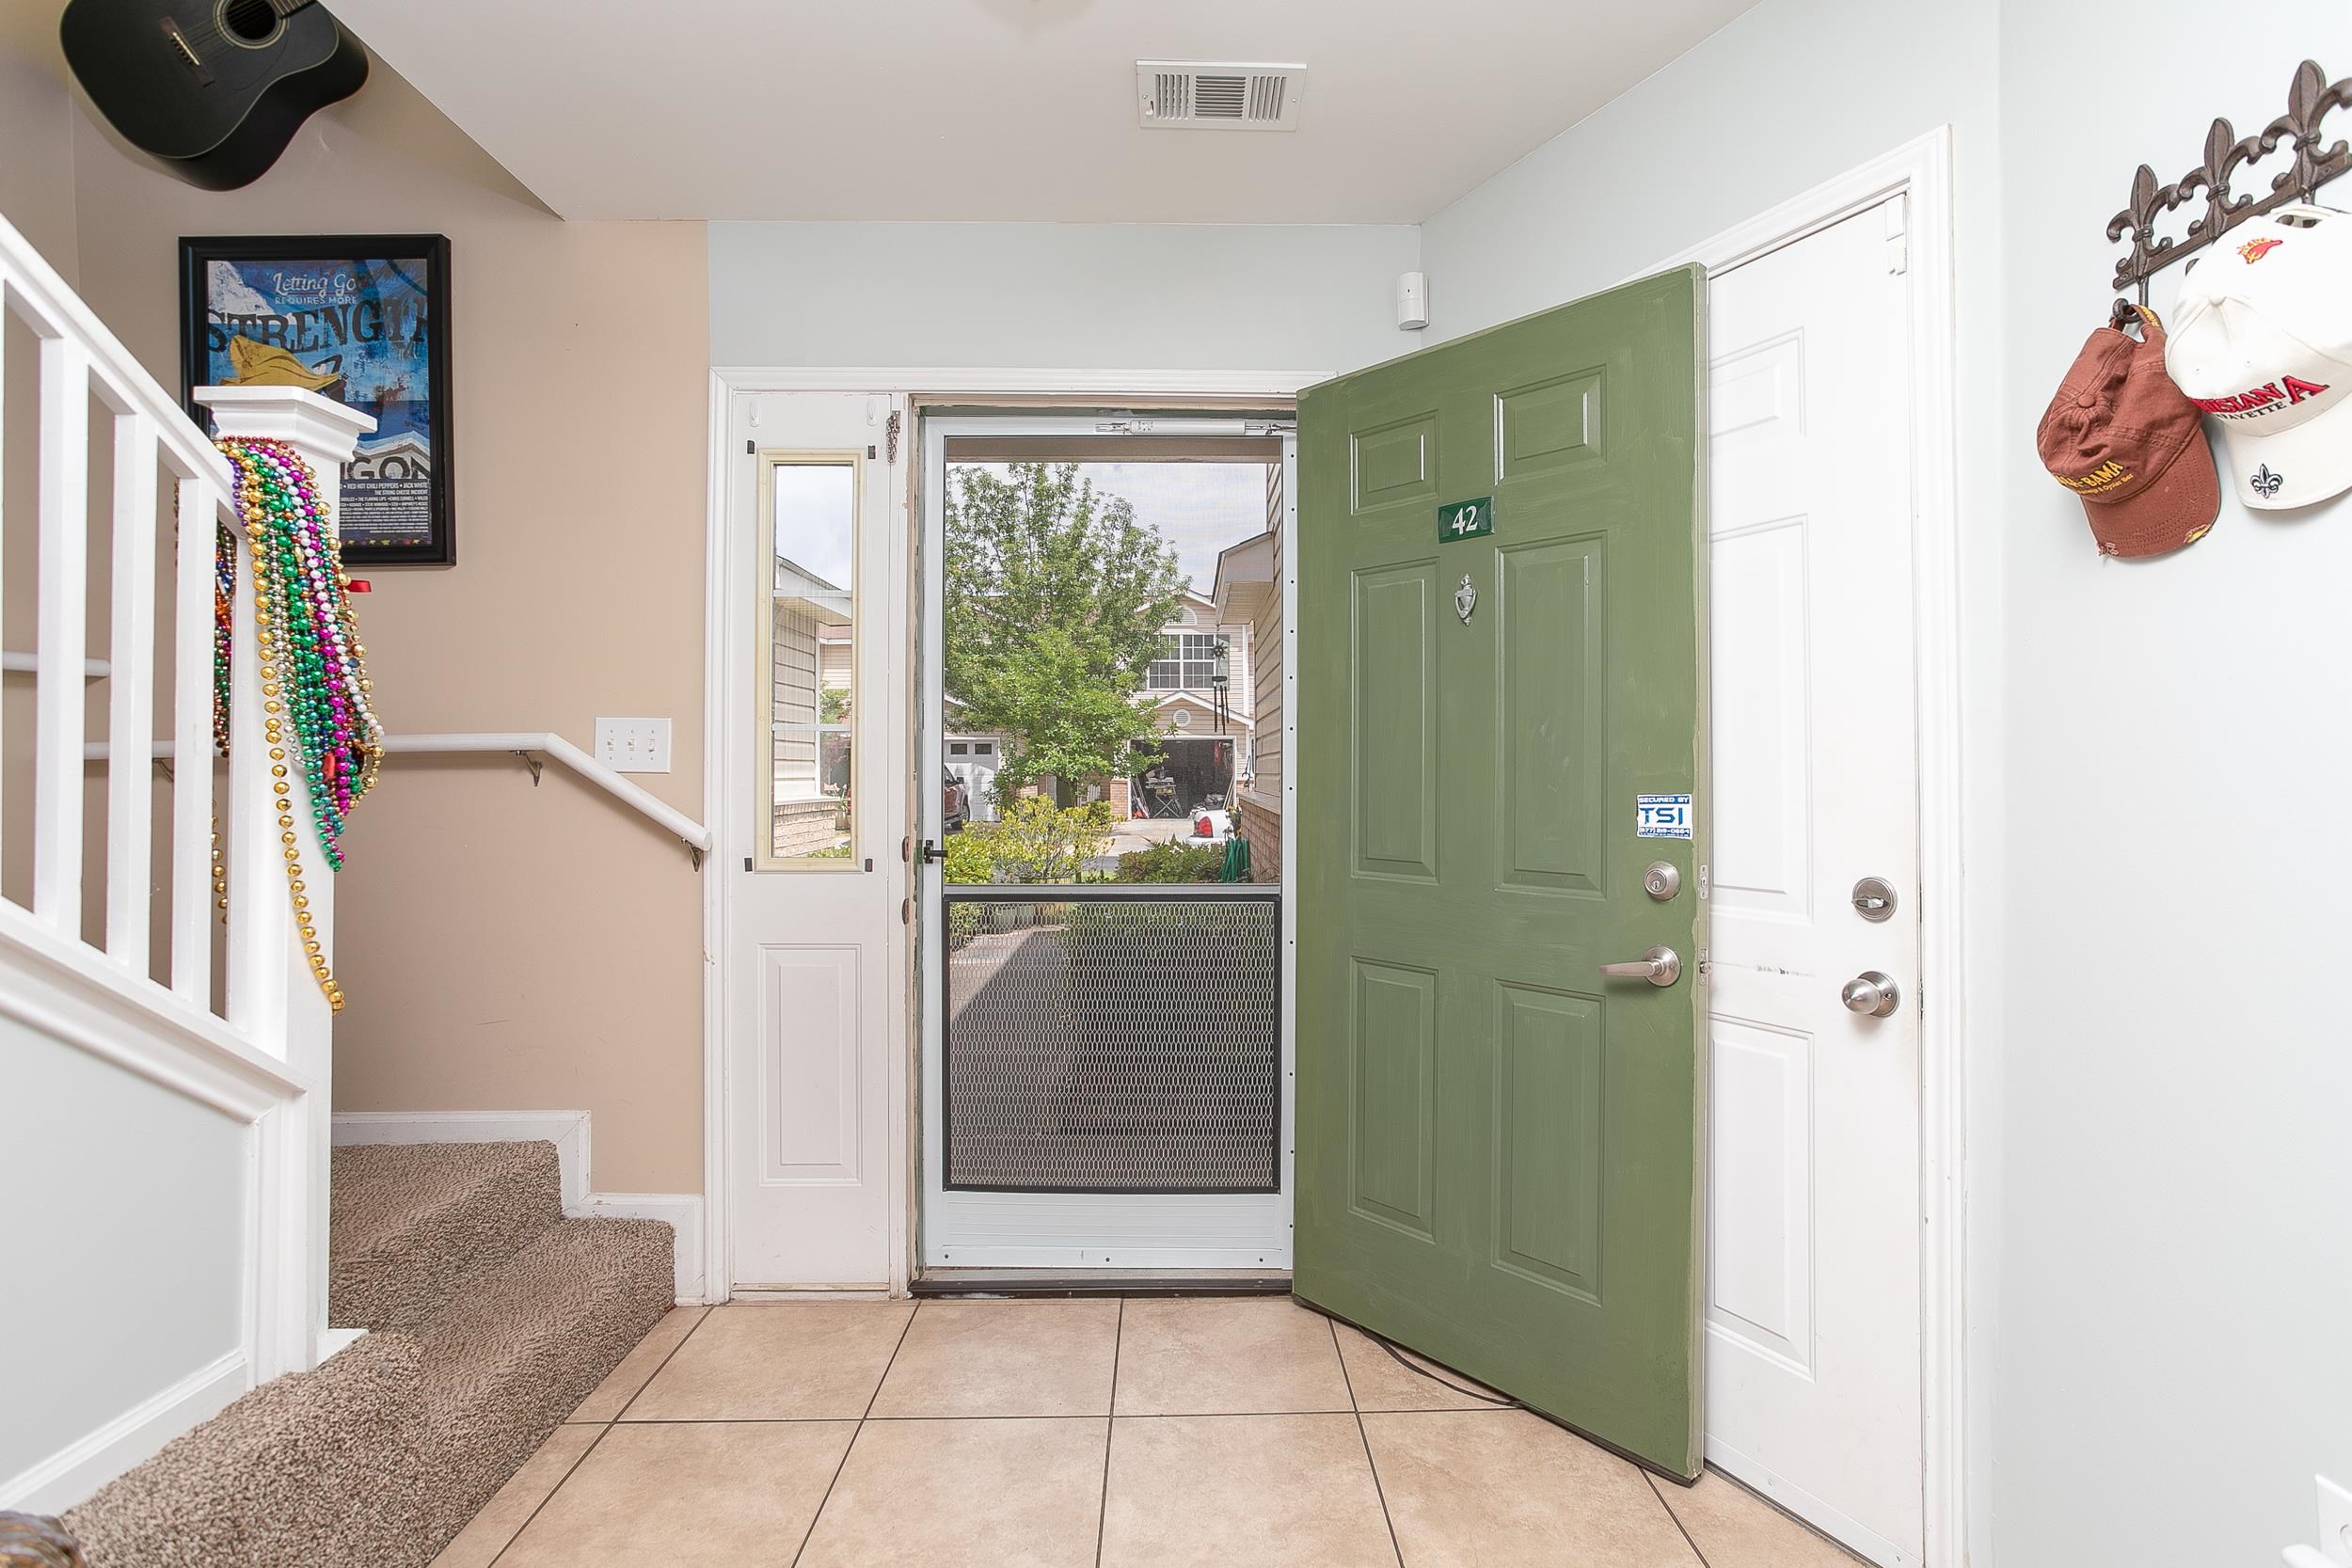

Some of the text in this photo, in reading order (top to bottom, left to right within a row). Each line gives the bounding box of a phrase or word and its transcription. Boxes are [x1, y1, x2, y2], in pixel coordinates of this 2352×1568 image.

[273, 272, 357, 297] Letting Go
[275, 295, 358, 305] REQUIRES MORE
[1452, 505, 1478, 535] 42
[1639, 807, 1684, 825] TSI
